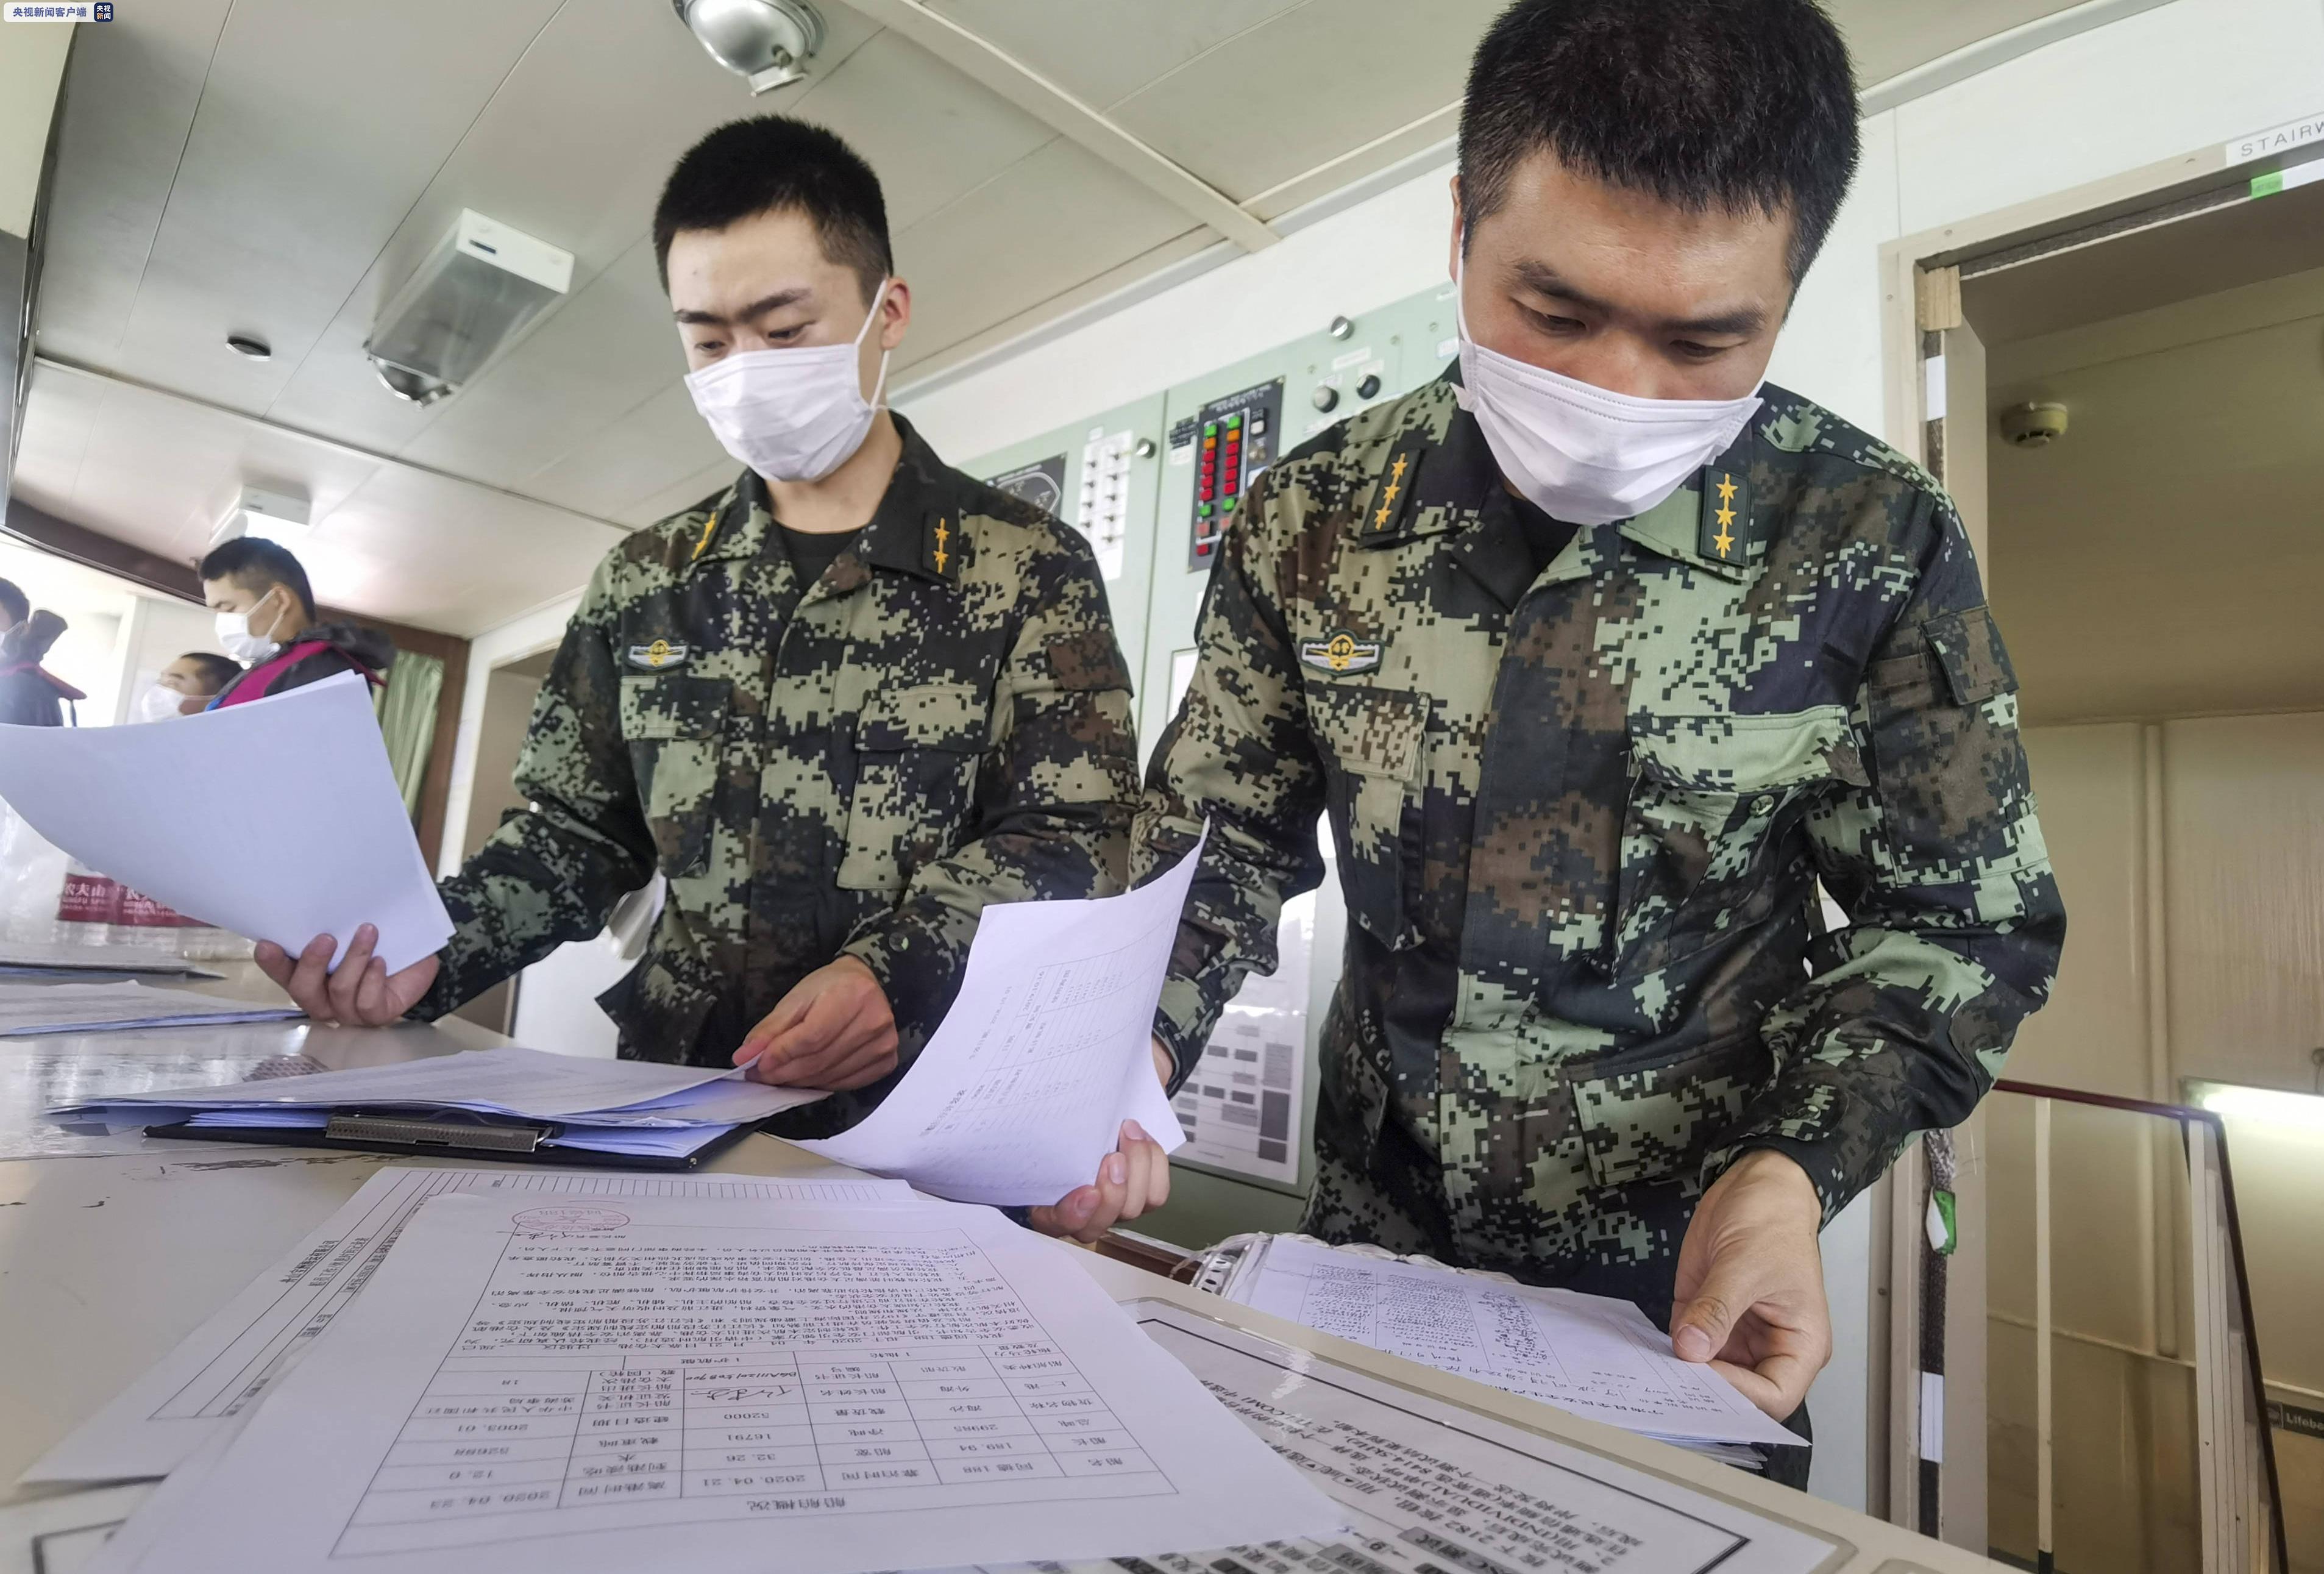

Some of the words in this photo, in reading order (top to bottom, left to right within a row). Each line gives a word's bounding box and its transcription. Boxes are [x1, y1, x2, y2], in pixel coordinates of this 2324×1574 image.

[820, 1387, 886, 1397] 船长姓名
[597, 1400, 670, 1410] 船长证书
[1028, 1398, 1093, 1409] 货物名称
[724, 1411, 769, 1421] 52000
[834, 1407, 886, 1417] 载货量
[592, 1416, 669, 1426] 建造日期
[1057, 1419, 1093, 1427] 总吨
[727, 1432, 772, 1442] 16791
[848, 1428, 883, 1437] 净吨
[1071, 1436, 1108, 1447] 船长
[727, 1453, 776, 1463] 32.26
[854, 1447, 892, 1458] 船宽
[1087, 1457, 1125, 1468] 船名
[703, 1473, 806, 1488] 2020.04.21
[841, 1469, 920, 1481] 靠泊时间
[578, 1481, 666, 1496] 离港时间
[747, 1495, 846, 1513] 船舶概况
[1444, 1520, 1493, 1545] 2182
[1413, 1533, 1467, 1561] 测试
